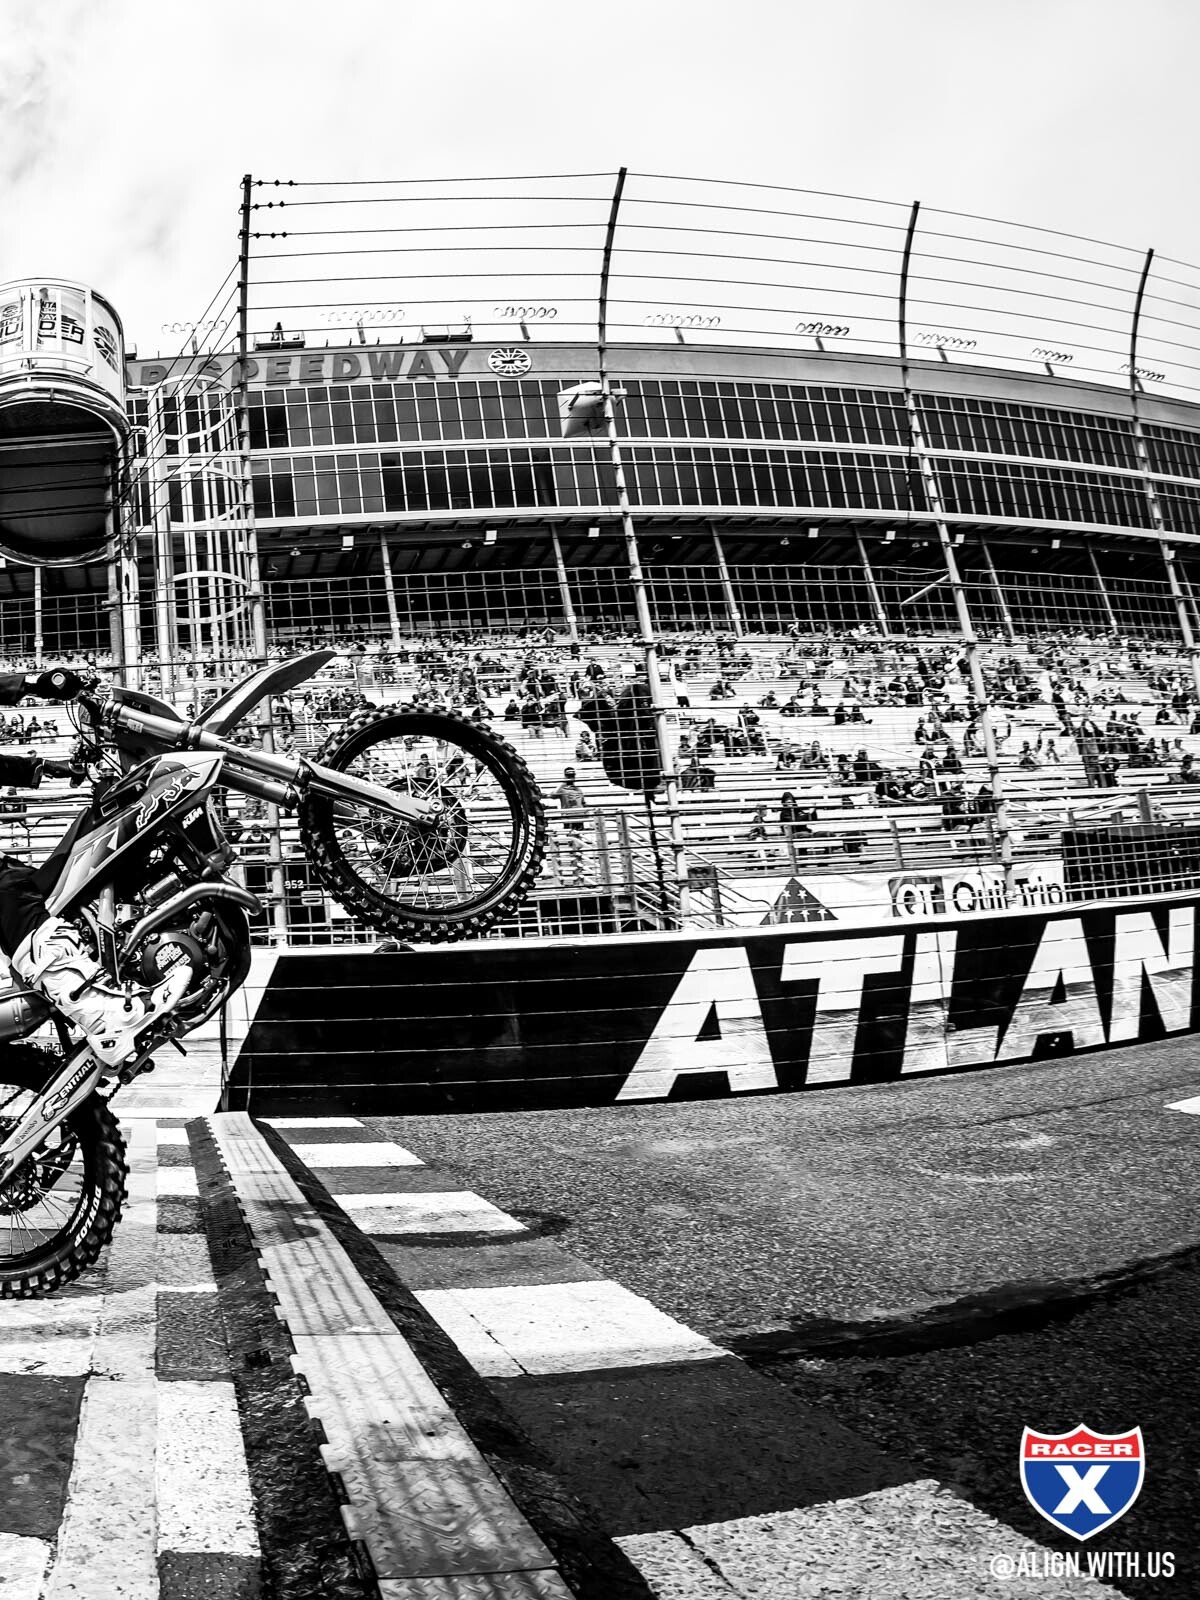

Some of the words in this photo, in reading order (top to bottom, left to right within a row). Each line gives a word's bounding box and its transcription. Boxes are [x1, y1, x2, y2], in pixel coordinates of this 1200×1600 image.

[196, 350, 469, 391] SPEEDWAY
[182, 807, 204, 829] KTM
[521, 815, 537, 872] DUNLOP
[41, 1058, 95, 1122] RENTHAL
[73, 1184, 102, 1248] DUNLOP
